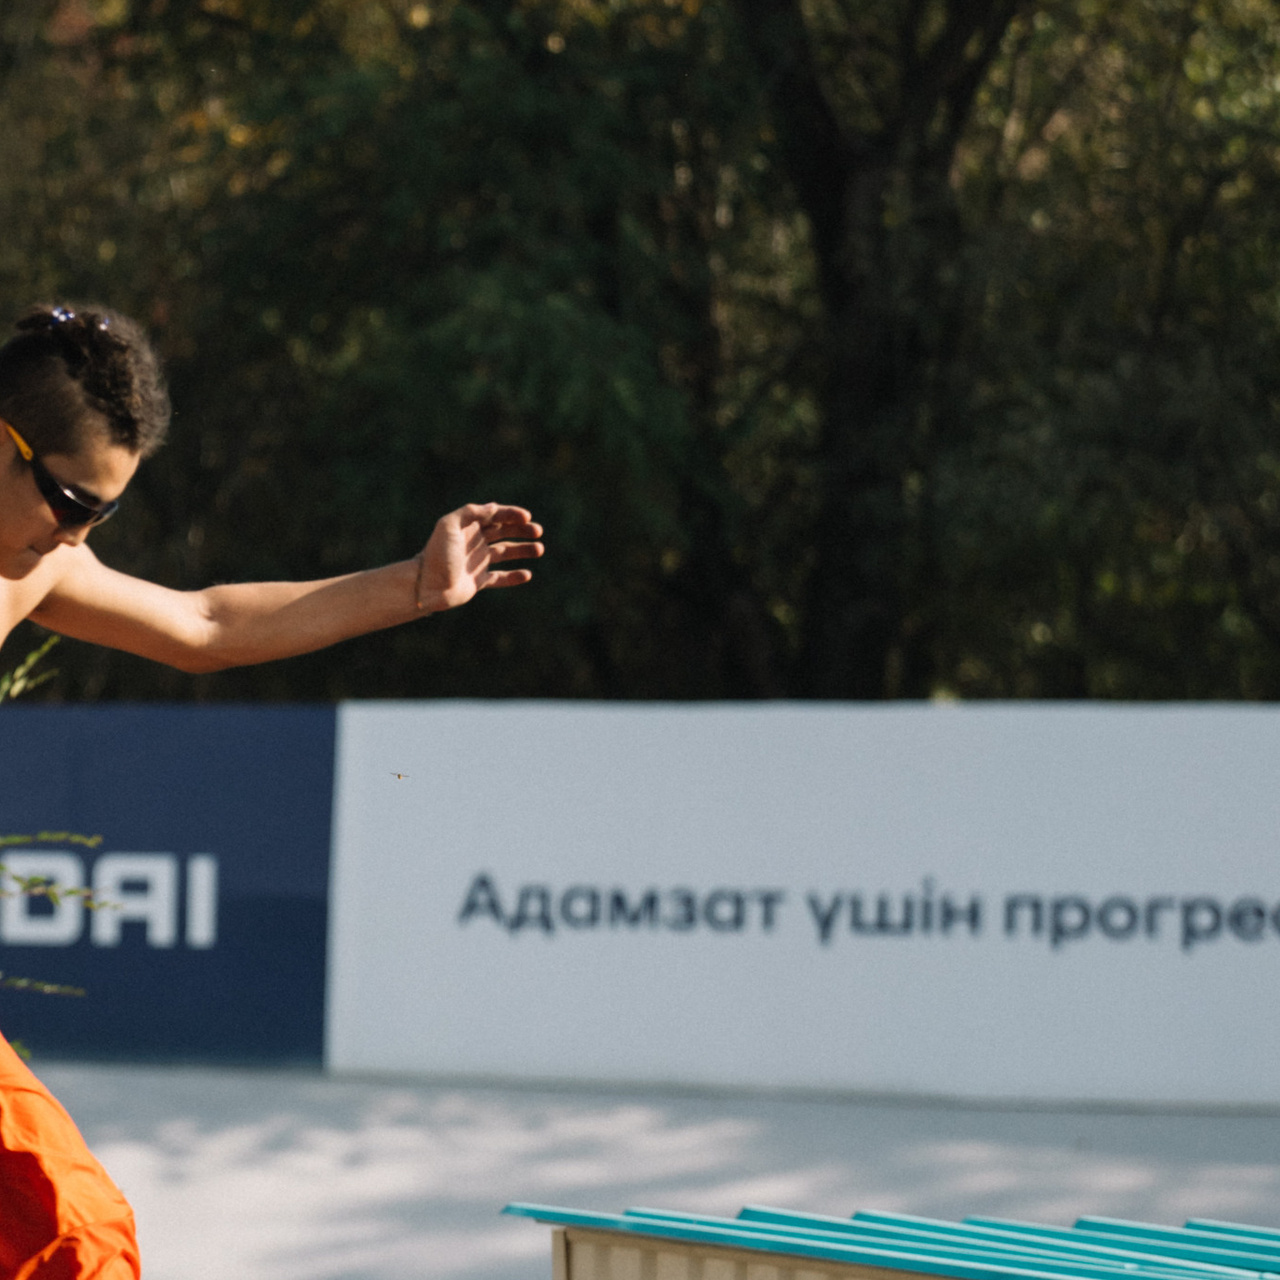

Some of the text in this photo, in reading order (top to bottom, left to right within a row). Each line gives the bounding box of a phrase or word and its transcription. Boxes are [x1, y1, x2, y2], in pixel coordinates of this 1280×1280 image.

[458, 870, 1280, 953] Адамзат үшін прогре
